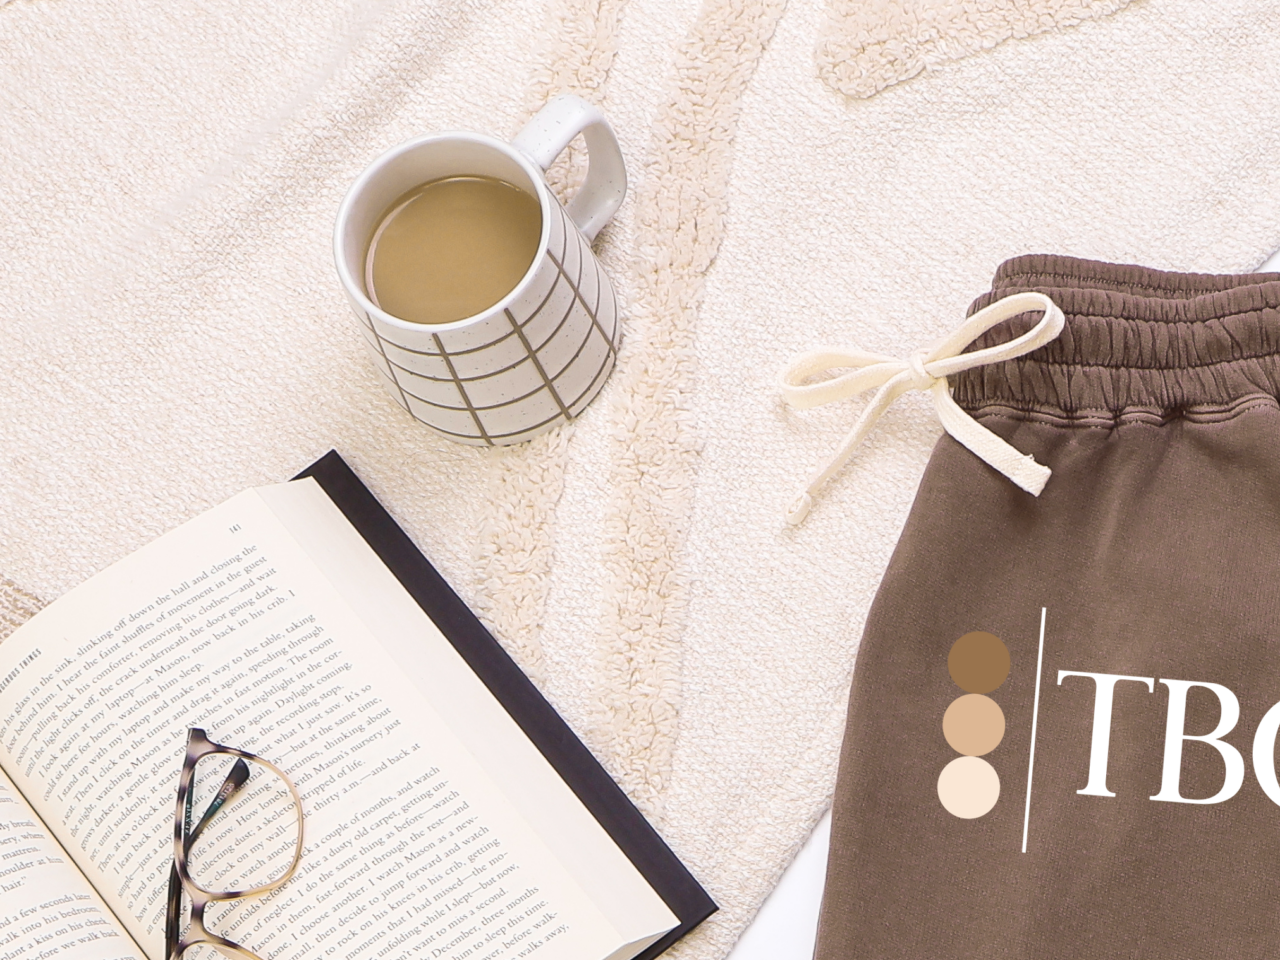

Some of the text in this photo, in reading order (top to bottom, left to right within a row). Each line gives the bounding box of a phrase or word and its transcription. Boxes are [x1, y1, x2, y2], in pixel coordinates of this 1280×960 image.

[13, 706, 39, 737] behind
[35, 692, 58, 711] him.
[61, 669, 83, 687] hear
[82, 658, 99, 671] the
[98, 642, 122, 660] faint
[121, 621, 155, 645] shuffles
[155, 610, 167, 624] of
[166, 586, 215, 617] movement
[213, 580, 227, 589] in
[225, 570, 242, 583] the
[243, 556, 268, 575] guest
[14, 695, 31, 717] glass
[30, 686, 41, 697] in
[39, 673, 55, 687] the
[54, 657, 77, 675] sink,
[76, 630, 115, 658] slinking
[113, 617, 128, 632] off
[128, 604, 156, 623] down
[154, 594, 172, 606] the
[170, 580, 191, 597] hall
[191, 570, 210, 586] and
[210, 554, 243, 575] closing
[241, 545, 258, 557] the
[18, 647, 41, 669] THINGS
[33, 746, 45, 761] the
[41, 727, 62, 748] light
[61, 708, 84, 730] clicks
[83, 693, 100, 710] off,
[98, 684, 114, 698] the
[114, 667, 140, 686] crack
[138, 635, 190, 670] underneath
[188, 626, 205, 638] the
[205, 612, 228, 629] door
[228, 597, 256, 618] going
[254, 585, 278, 601] dark.
[72, 782, 94, 803] Then
[98, 758, 119, 778] click
[118, 748, 131, 760] on
[130, 736, 146, 750] the
[145, 718, 171, 739] timer
[171, 704, 190, 722] and
[189, 692, 213, 709] drag
[211, 687, 220, 696] it
[220, 672, 249, 690] again,
[247, 647, 290, 674] speeding
[287, 625, 325, 650] through
[211, 650, 342, 731] from his nightlight in the cor-
[273, 728, 298, 745] what
[304, 713, 324, 730] just
[324, 701, 344, 716] saw.
[360, 684, 372, 694] so
[299, 911, 331, 936] choose
[331, 886, 369, 913] another.
[375, 861, 405, 882] watch
[403, 841, 437, 864] Mason
[437, 834, 447, 844] as
[455, 816, 479, 833] new-
[324, 946, 337, 956] to
[336, 929, 359, 948] rock
[359, 920, 374, 932] on
[371, 909, 389, 922] his
[387, 891, 417, 912] knees
[415, 883, 428, 894] in
[426, 873, 444, 886] his
[444, 860, 467, 876] crib,
[467, 838, 501, 864] getting
[32, 933, 54, 946] kiss
[54, 927, 69, 937] on
[66, 921, 85, 932] his
[501, 928, 533, 950] before
[532, 912, 558, 930] walk-
[517, 939, 544, 959] walks
[543, 924, 570, 942] away,
